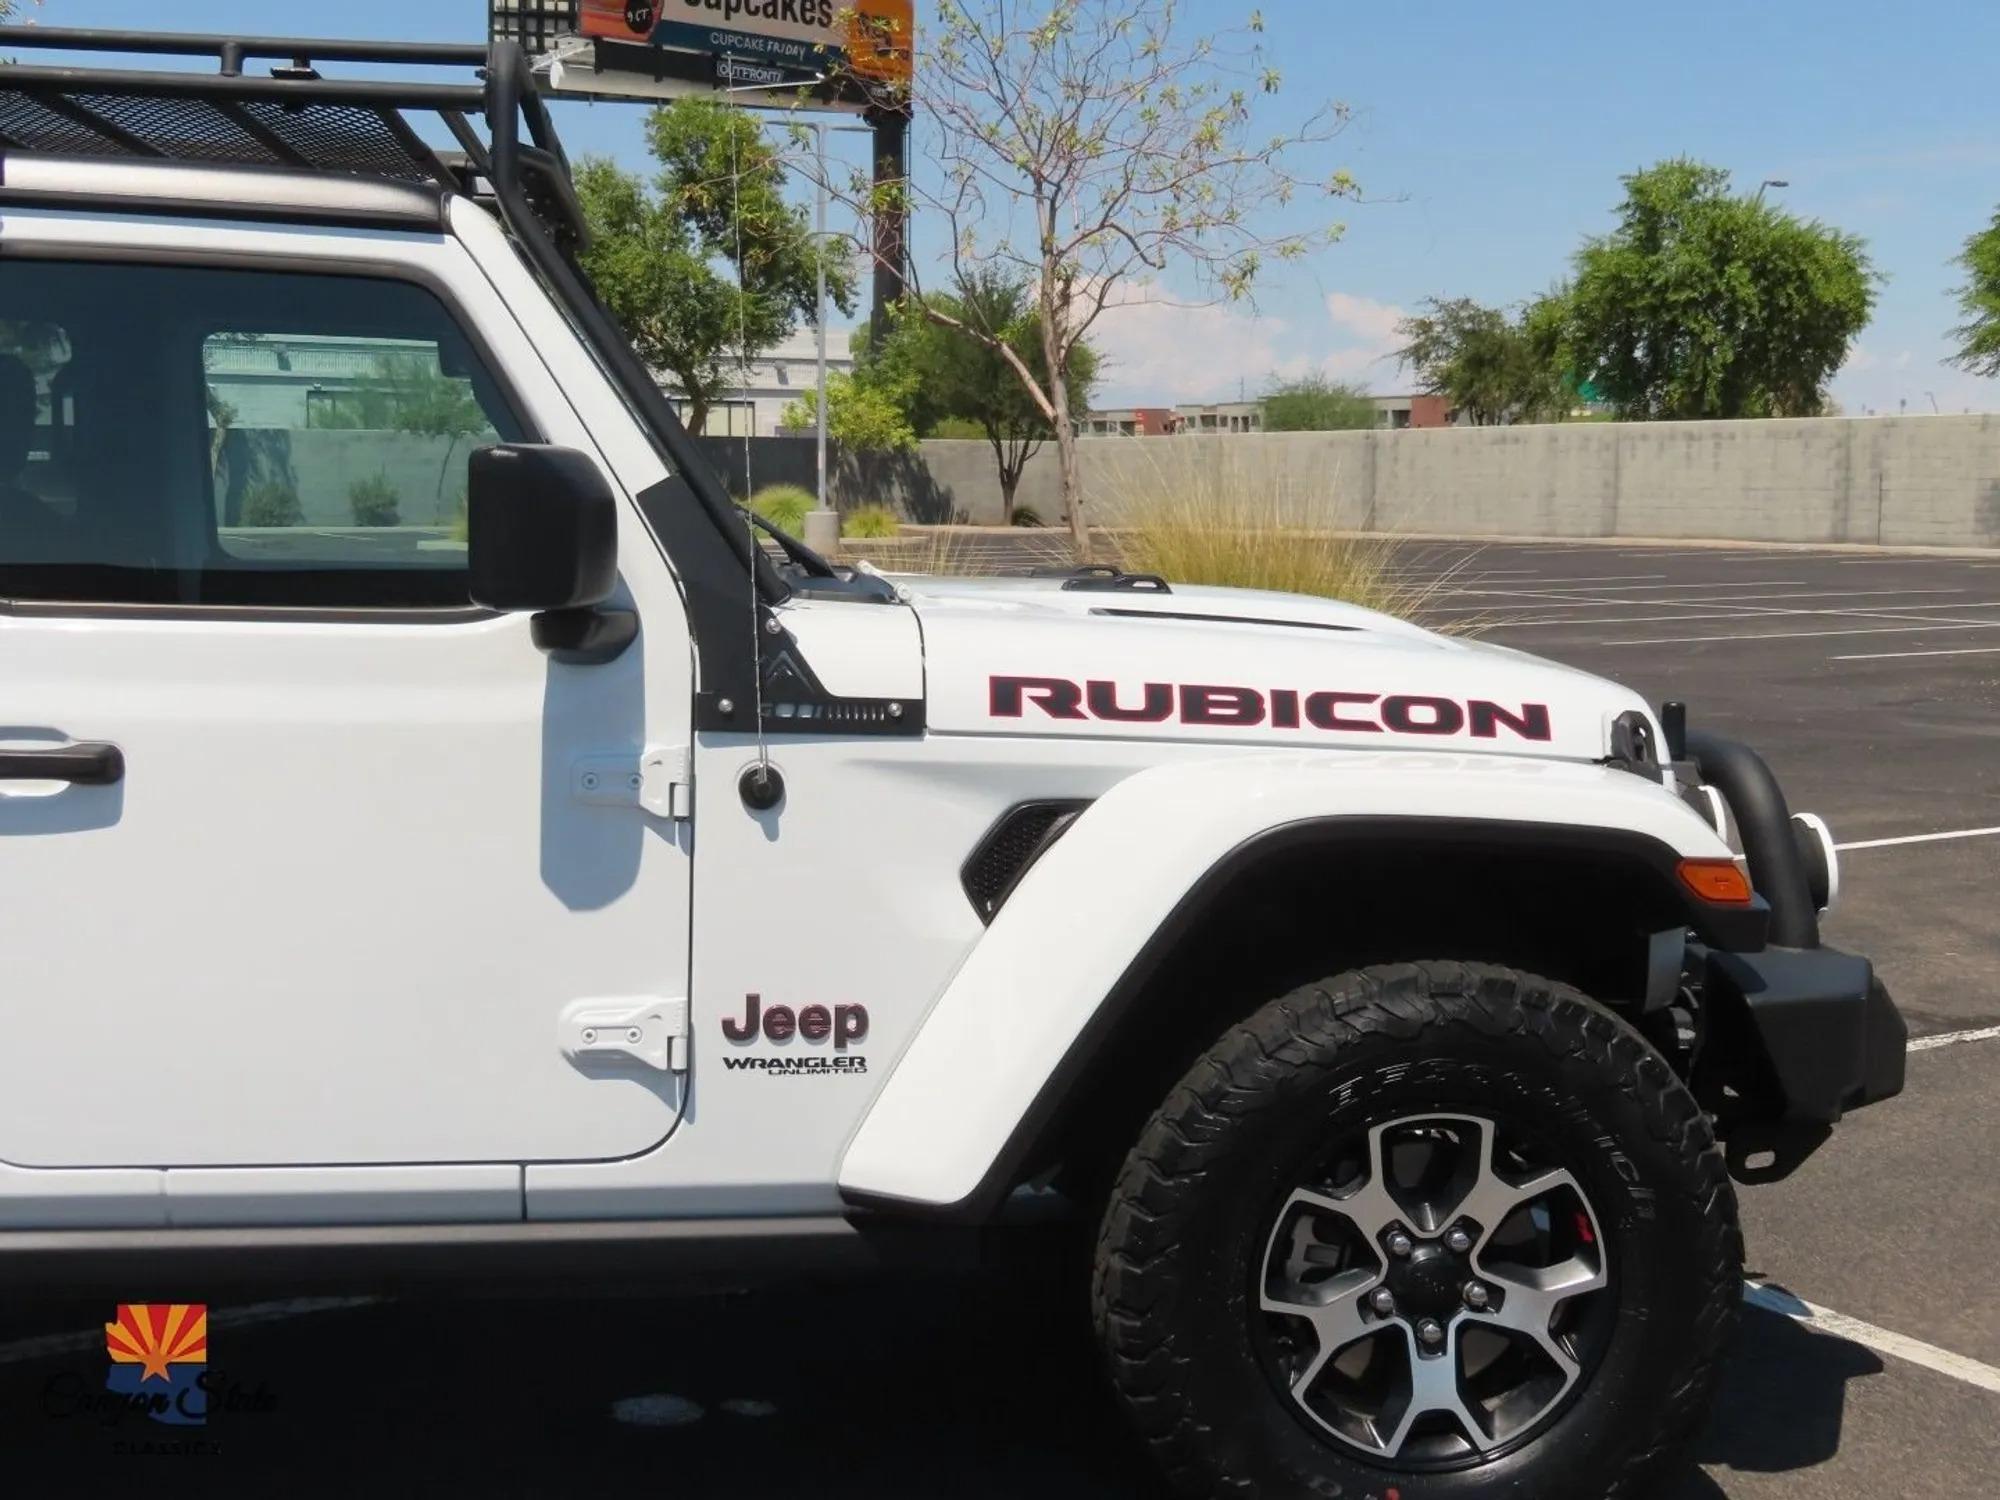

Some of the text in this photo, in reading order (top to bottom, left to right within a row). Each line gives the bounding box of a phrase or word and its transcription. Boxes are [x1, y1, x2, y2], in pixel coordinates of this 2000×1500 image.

[710, 32, 806, 61] CUPCAKE FRIDAY
[989, 675, 1552, 741] RUBICON
[721, 993, 869, 1049] Jeep
[722, 1057, 867, 1070] WRANGLER
[768, 1067, 868, 1075] UNLIMITED
